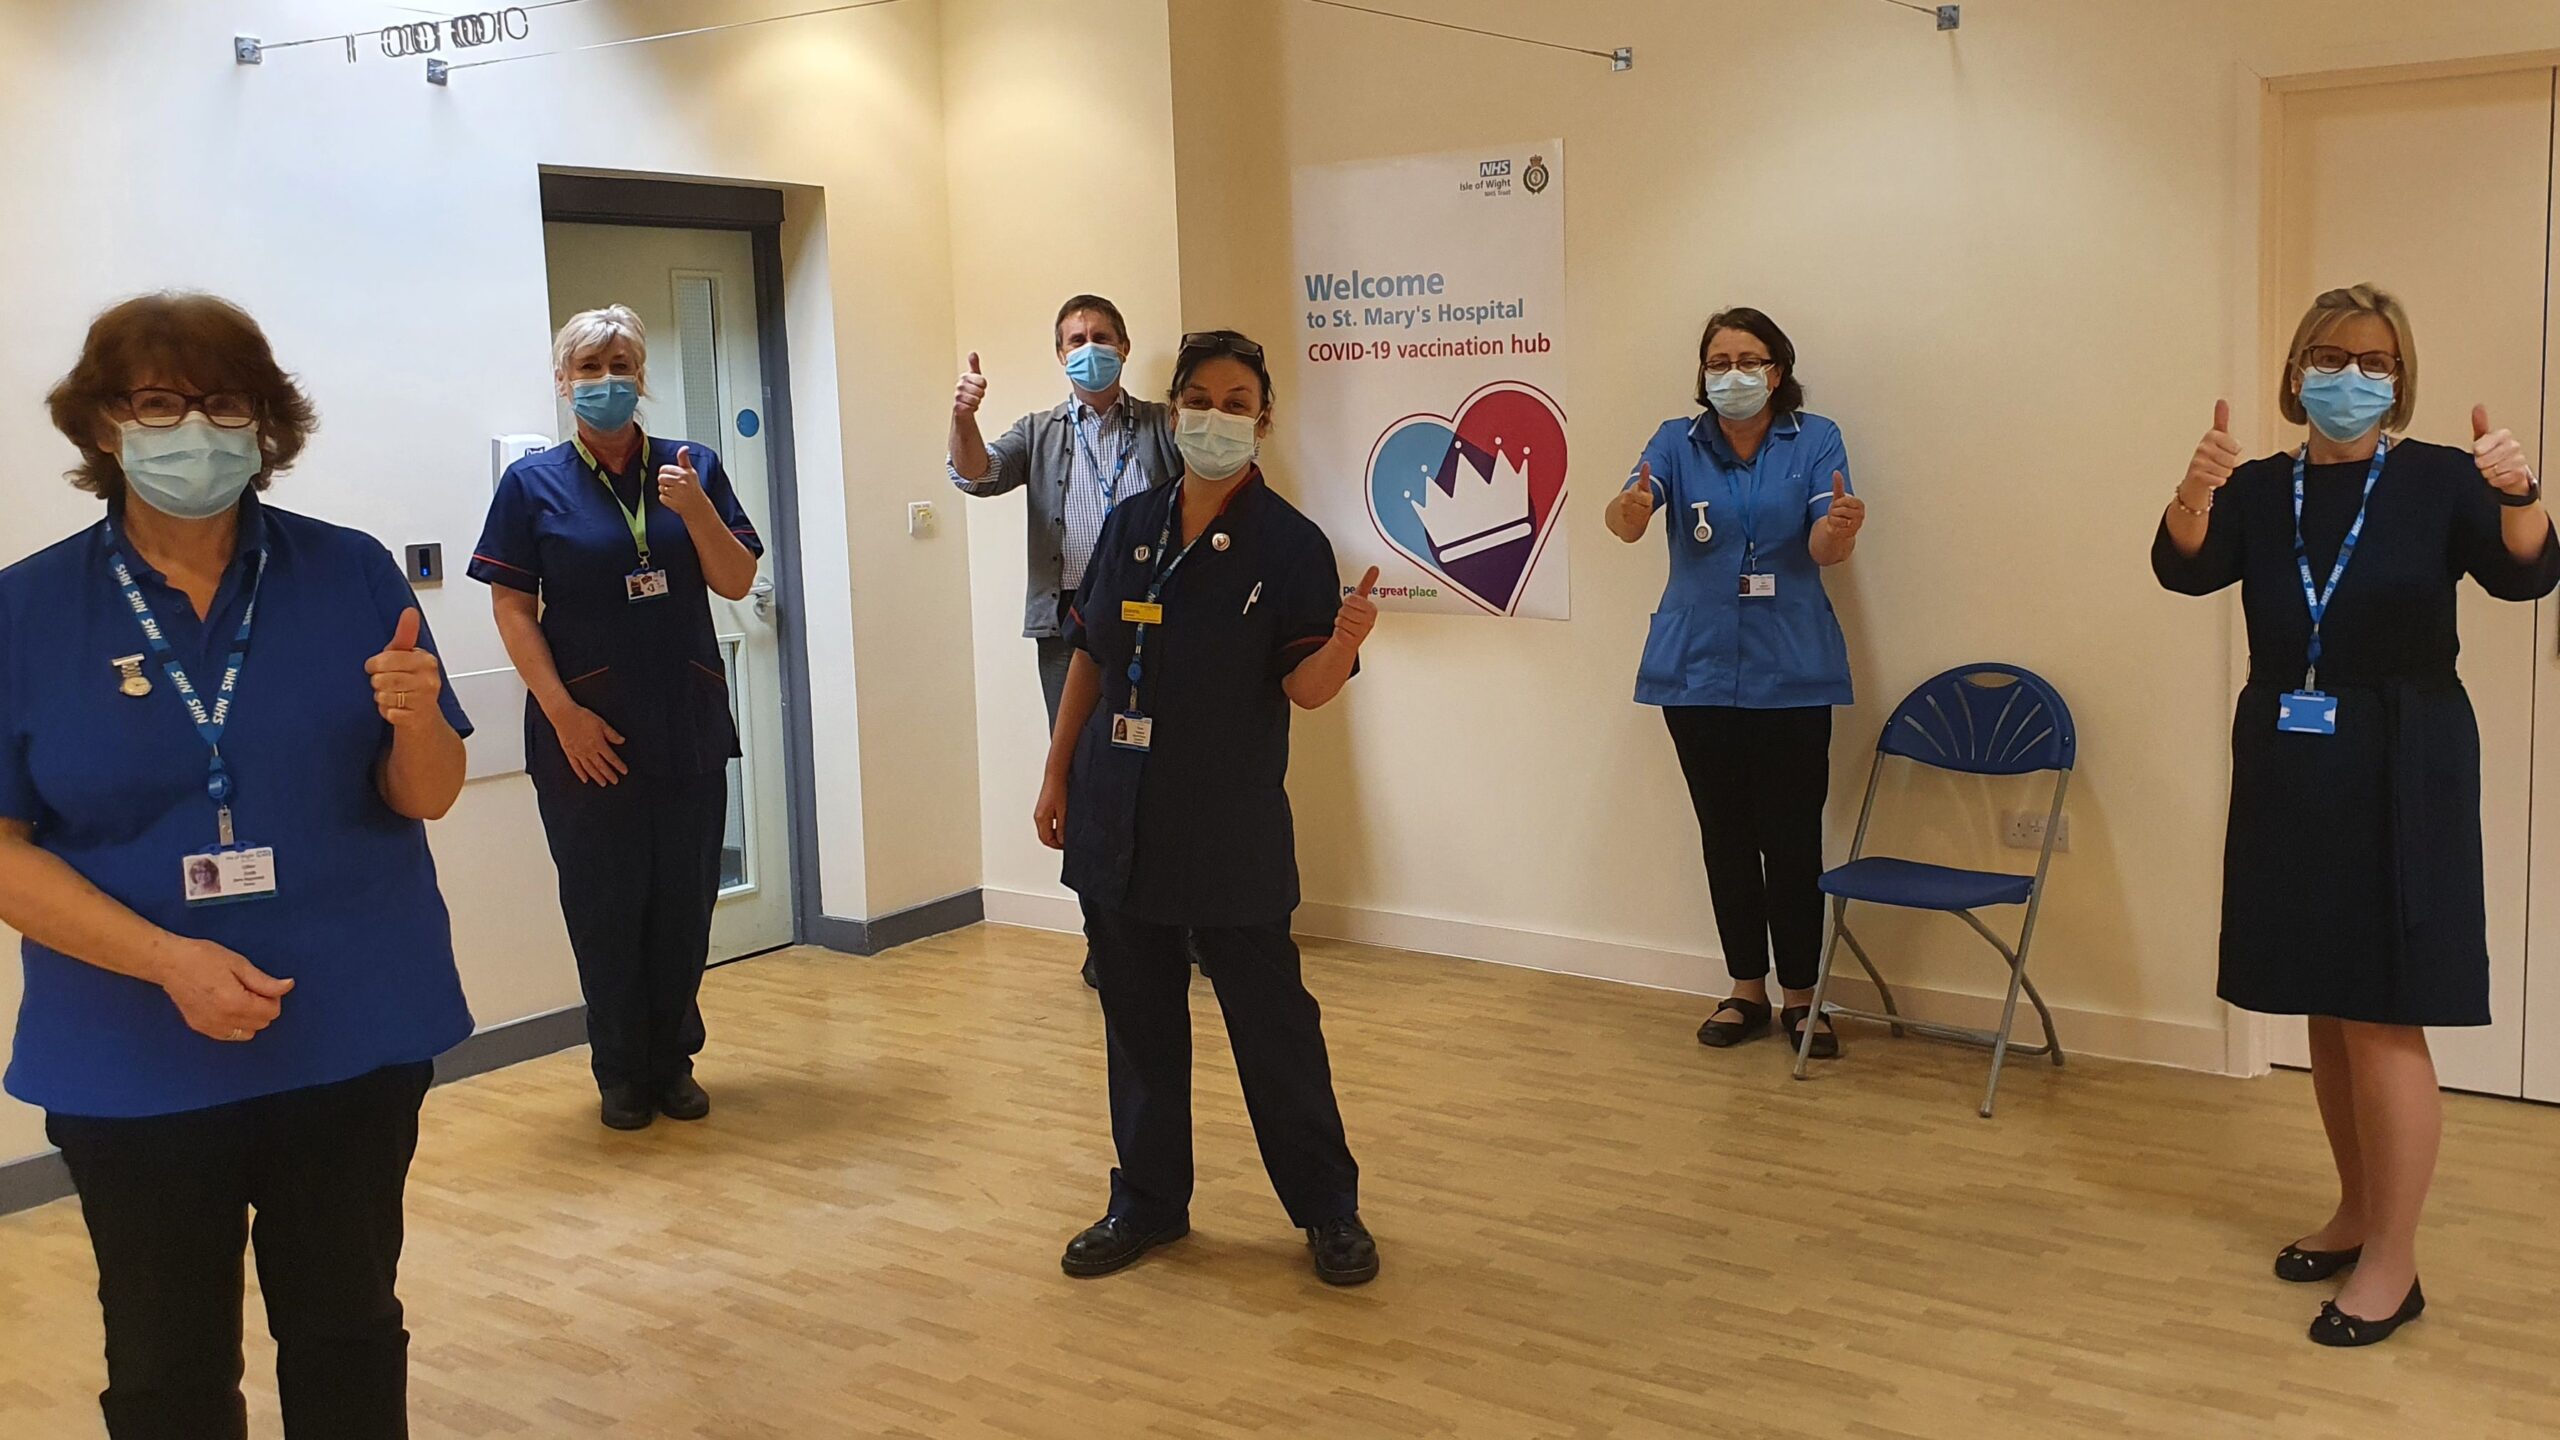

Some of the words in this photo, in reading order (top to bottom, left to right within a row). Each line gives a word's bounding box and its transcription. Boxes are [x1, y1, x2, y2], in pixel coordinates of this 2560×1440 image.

[1481, 161, 1509, 176] NHS
[1459, 182, 1473, 191] Isle
[1475, 181, 1484, 190] of
[1485, 179, 1511, 189] Wight
[1304, 270, 1445, 302] Welcome
[1307, 312, 1326, 328] to
[1332, 309, 1357, 327] St.
[1364, 306, 1431, 329] Mary's
[1438, 298, 1524, 325] Hospital
[1308, 341, 1391, 362] COVID-19
[1397, 336, 1504, 359] vaccination
[1511, 332, 1551, 354] hub
[115, 563, 133, 586] NHS
[2300, 564, 2312, 584] NHS
[127, 590, 148, 613] NHS
[2306, 587, 2318, 607] NHS
[141, 618, 162, 640] NHS
[171, 670, 194, 693] NHS
[221, 667, 238, 692] NHS
[187, 698, 209, 724] NHS
[212, 697, 229, 725] NHS
